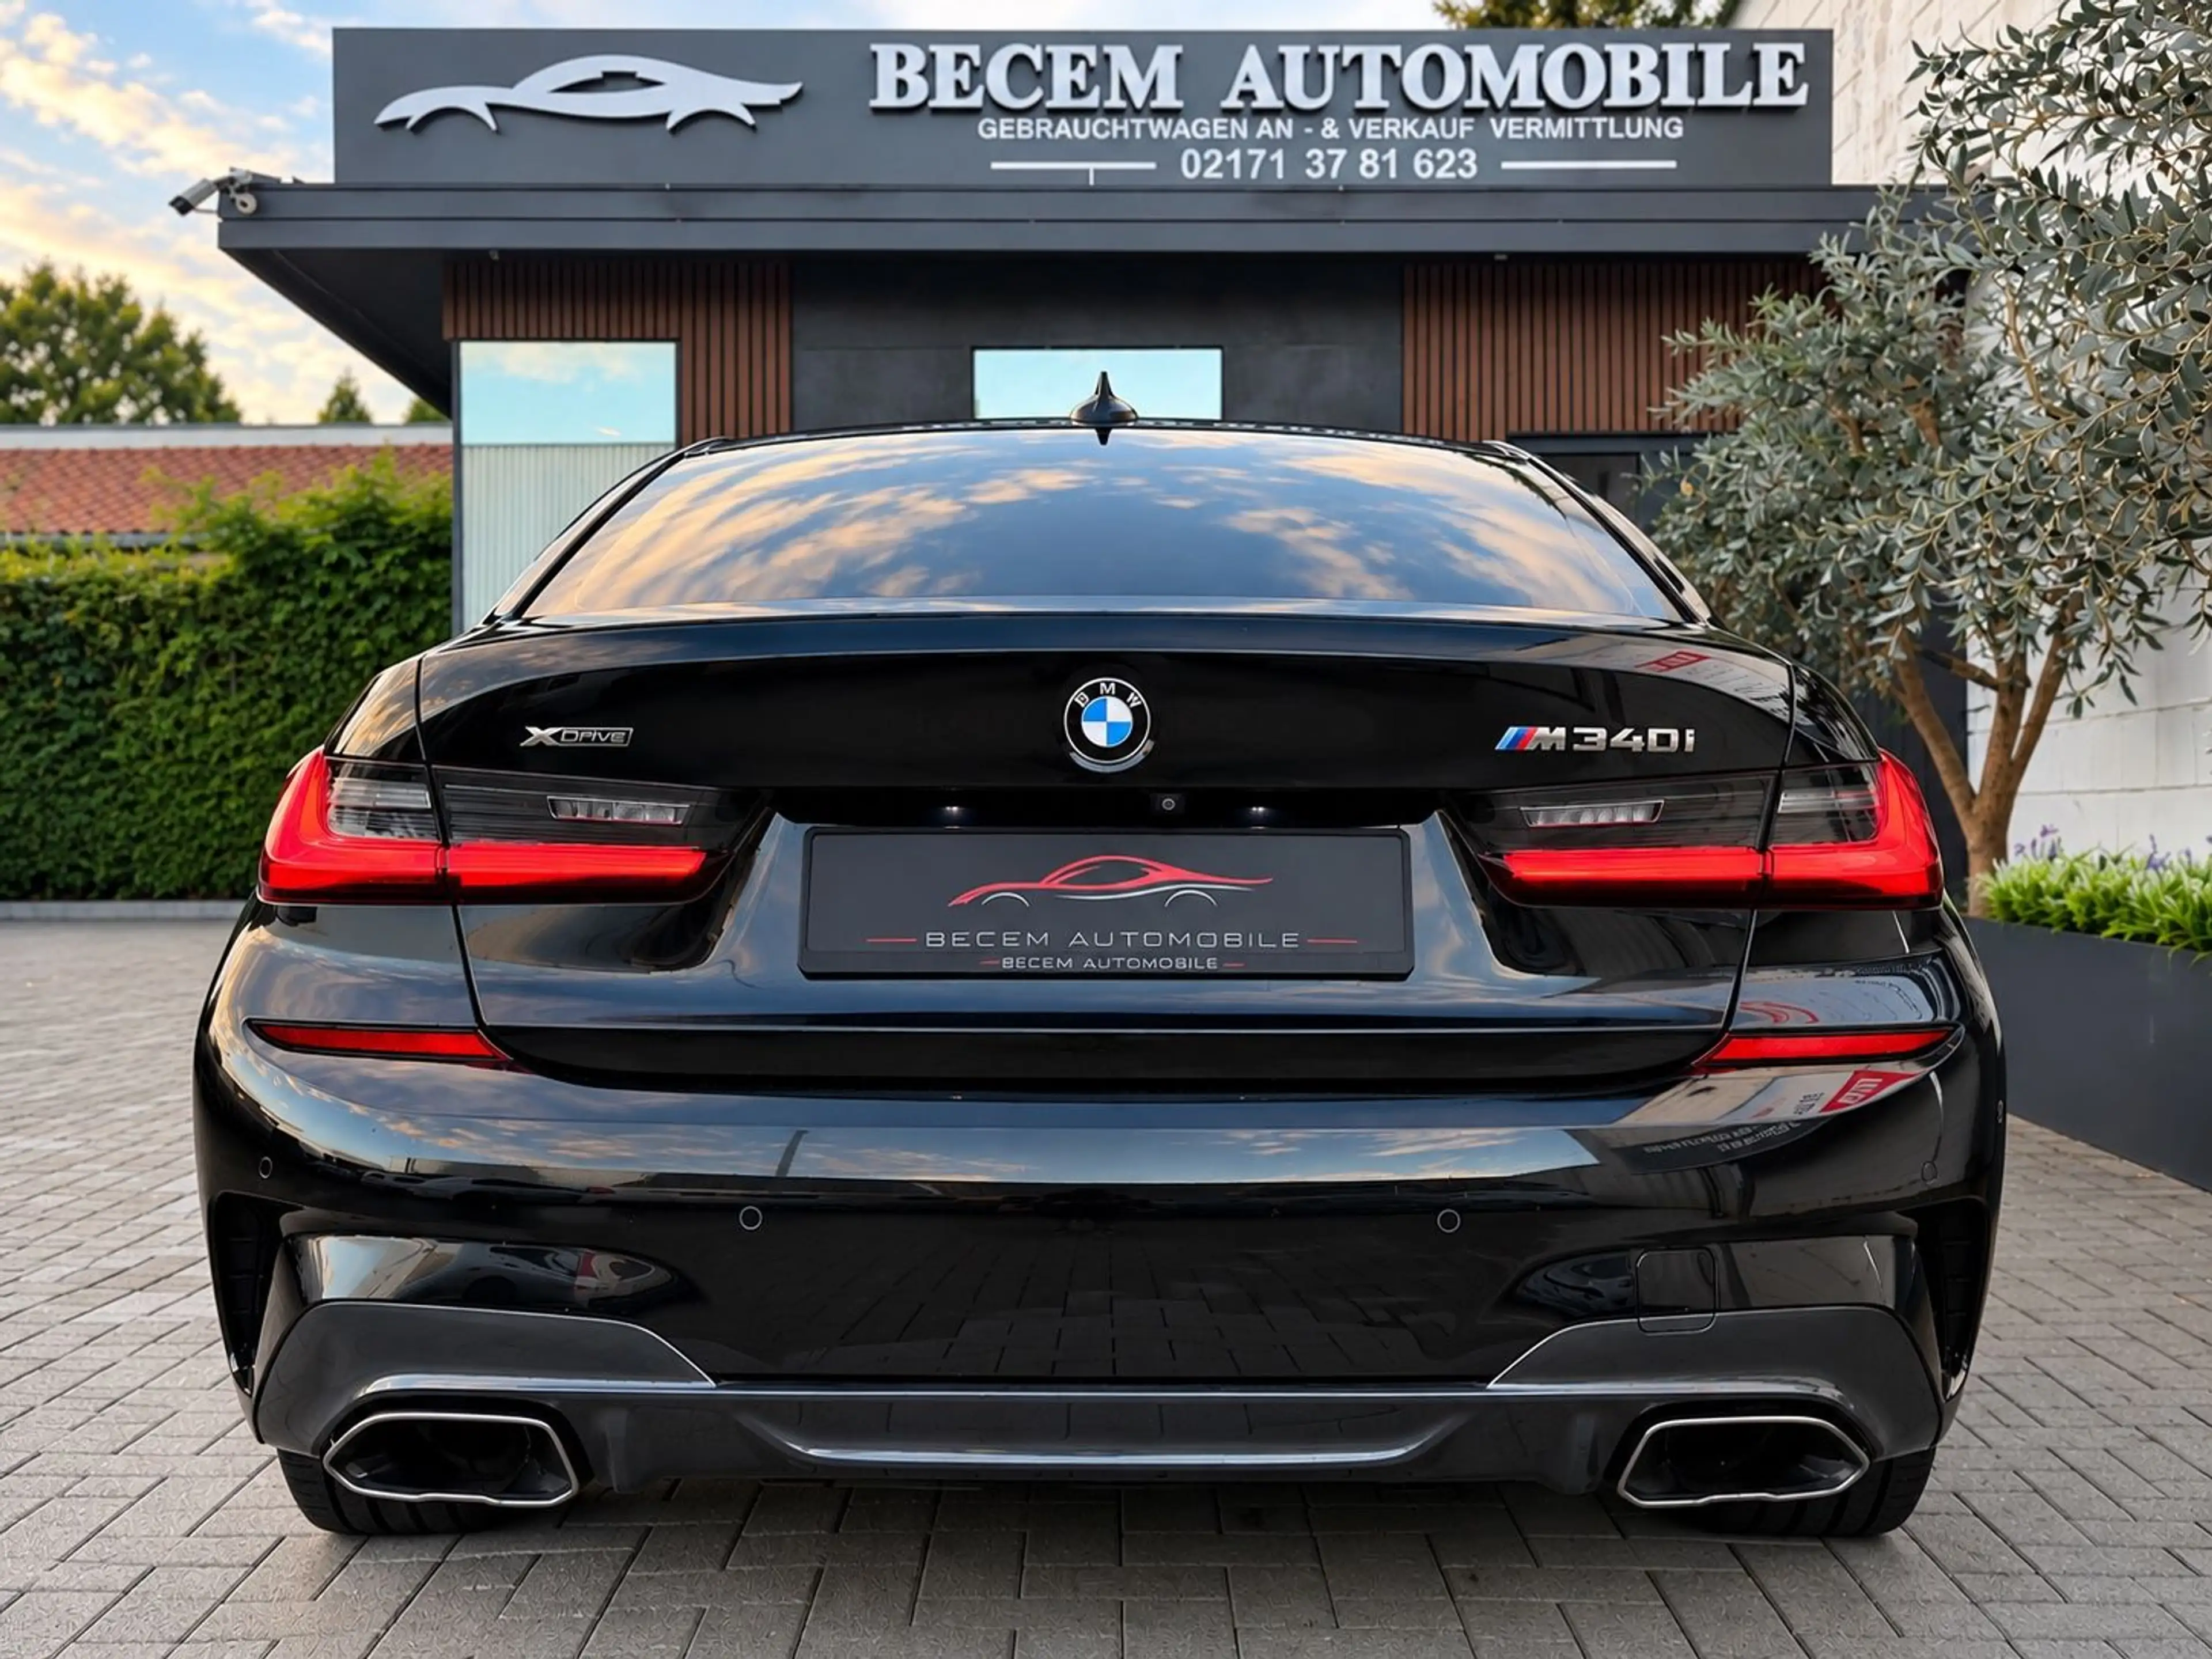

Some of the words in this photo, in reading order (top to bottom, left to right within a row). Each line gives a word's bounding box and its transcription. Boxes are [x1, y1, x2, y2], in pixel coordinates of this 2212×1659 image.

[869, 43, 1184, 109] BECEM
[1219, 42, 1809, 109] AUTOMOBILE
[977, 117, 1249, 140] GEBRAUCHTWAGEN
[1255, 117, 1294, 140] AN
[1320, 117, 1341, 140] &
[1347, 117, 1475, 140] VERKAUF
[1489, 116, 1684, 139] VERMITTLUNG
[1180, 147, 1285, 180] 02171
[1304, 147, 1349, 180] 37
[1358, 147, 1397, 180] 81
[1412, 147, 1479, 180] 623
[1074, 682, 1142, 708] BMW
[1524, 726, 1695, 752] M340i
[925, 931, 1049, 948] BECEM
[1068, 931, 1300, 949] AUTOMOBILE
[1001, 956, 1074, 969] BECEM
[1082, 957, 1218, 969] AUTOMOBILE
